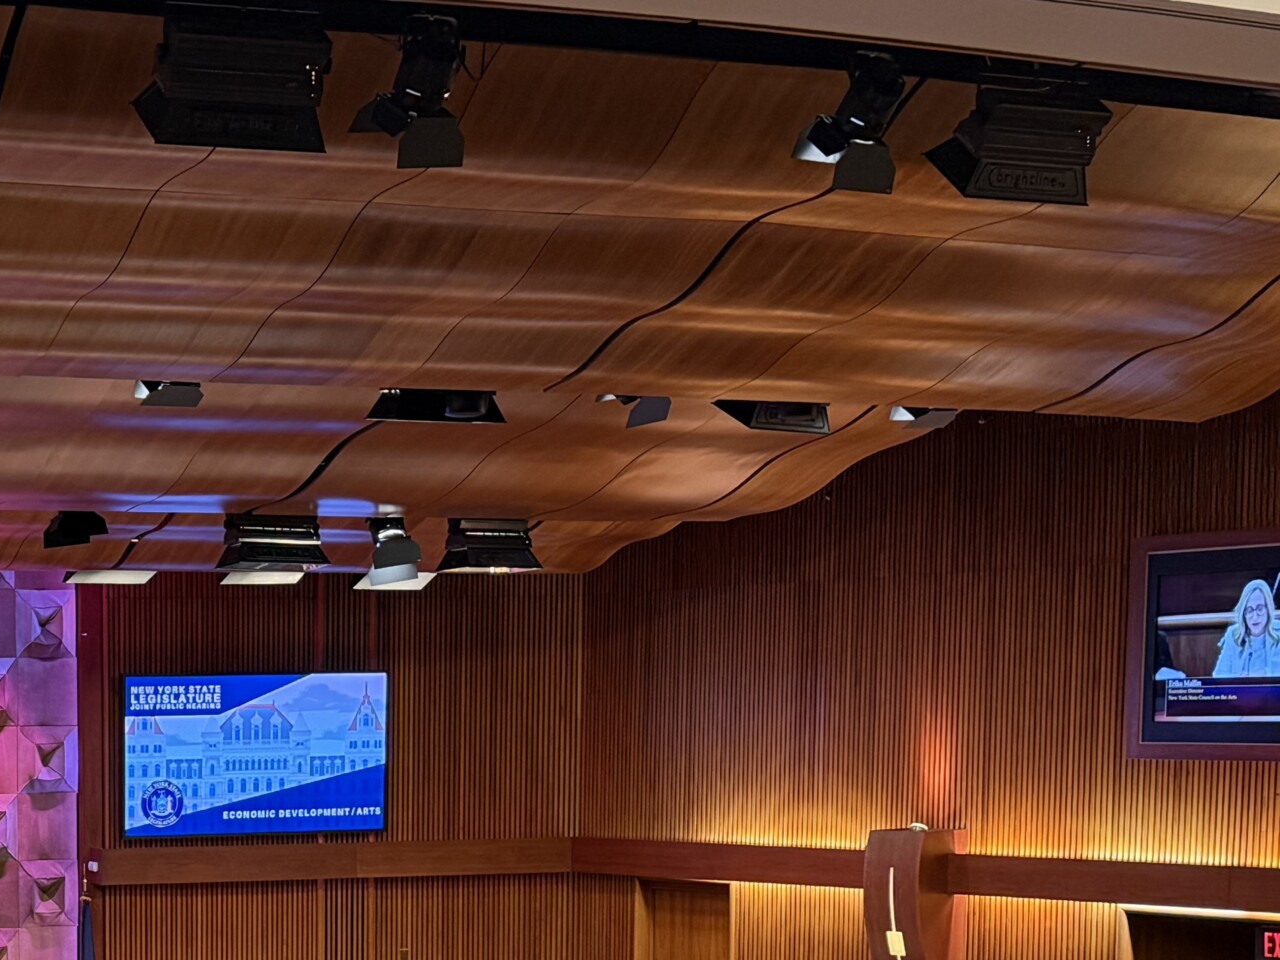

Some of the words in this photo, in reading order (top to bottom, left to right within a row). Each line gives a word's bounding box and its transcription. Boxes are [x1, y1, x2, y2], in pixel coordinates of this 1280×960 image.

[158, 686, 185, 694] YORK
[188, 685, 221, 693] STATE
[130, 694, 221, 704] LEGISLATURE
[223, 810, 275, 819] ECONOMIC
